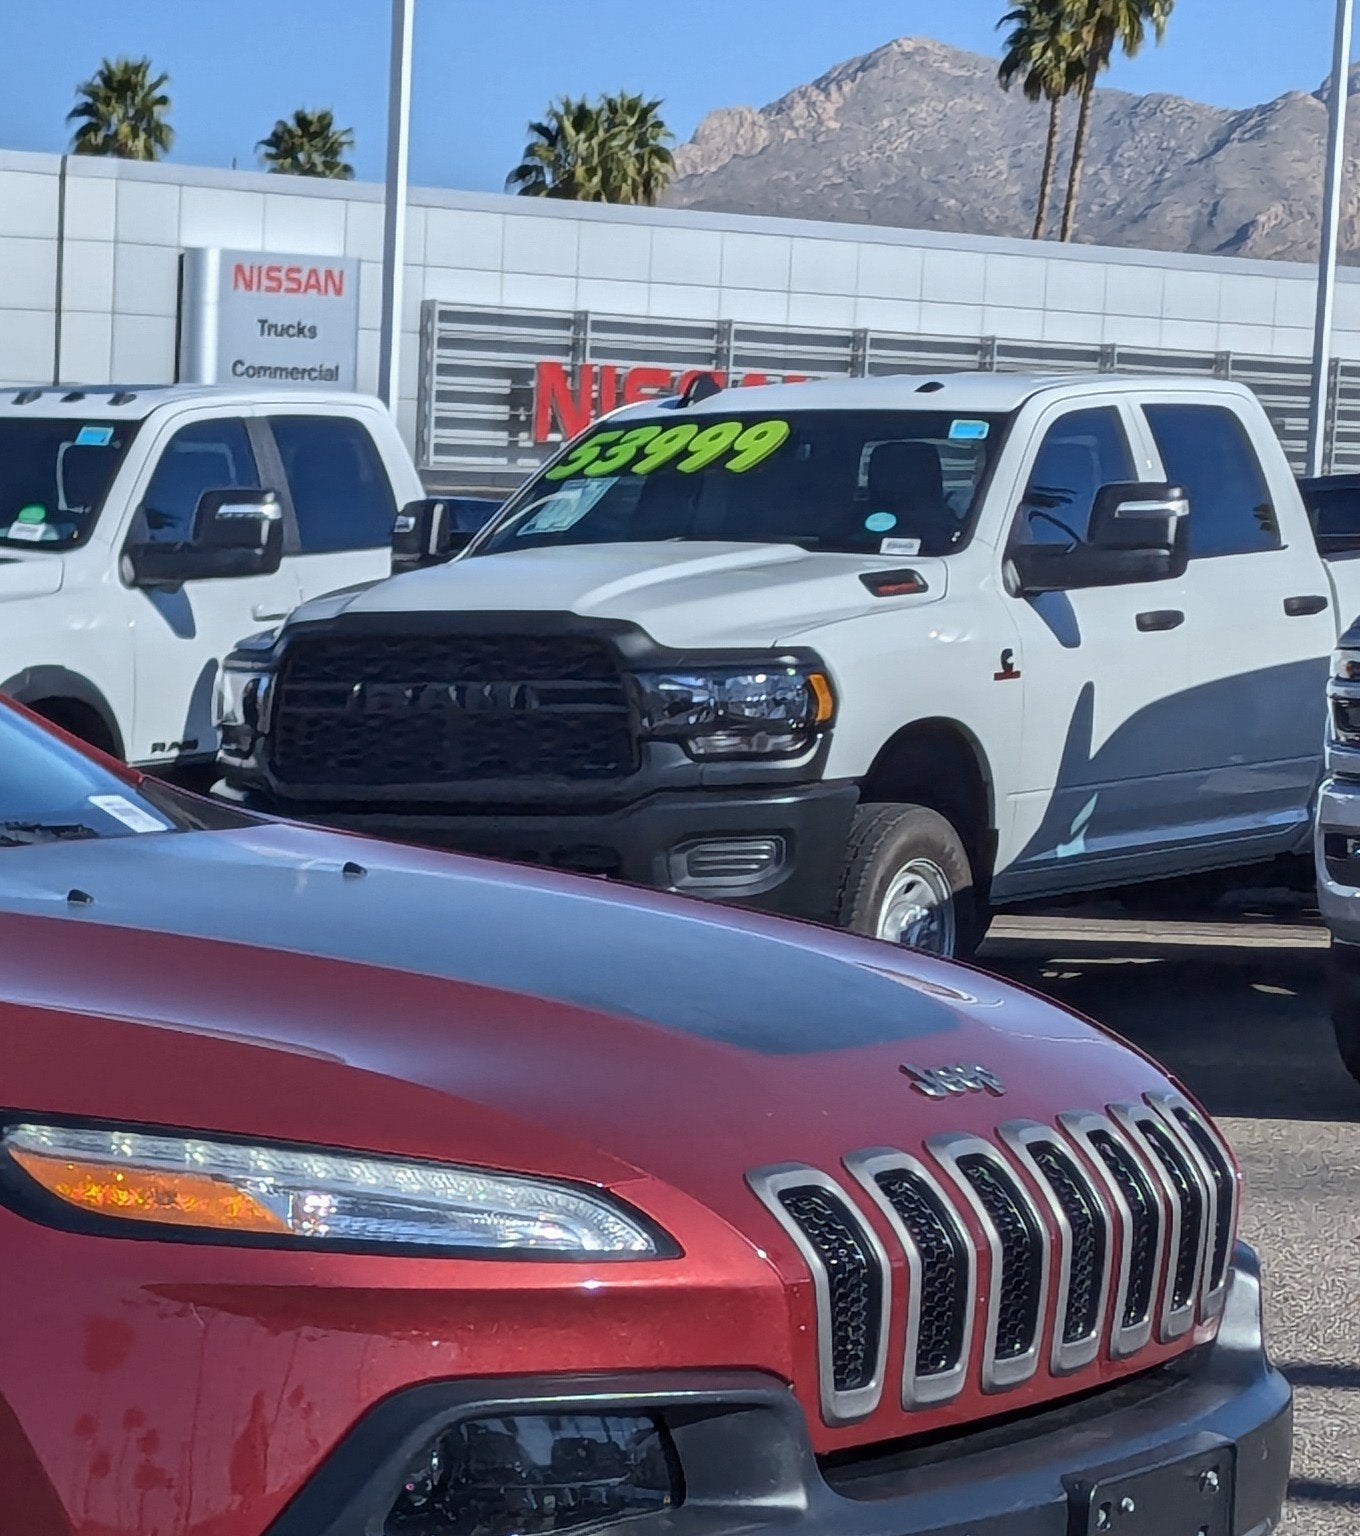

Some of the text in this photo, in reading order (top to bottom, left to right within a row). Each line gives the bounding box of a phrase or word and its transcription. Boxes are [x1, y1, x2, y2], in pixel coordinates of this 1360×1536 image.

[233, 263, 343, 297] NISSAN
[257, 318, 317, 339] Trucks
[231, 359, 339, 381] Commercial
[545, 420, 791, 480] 53999
